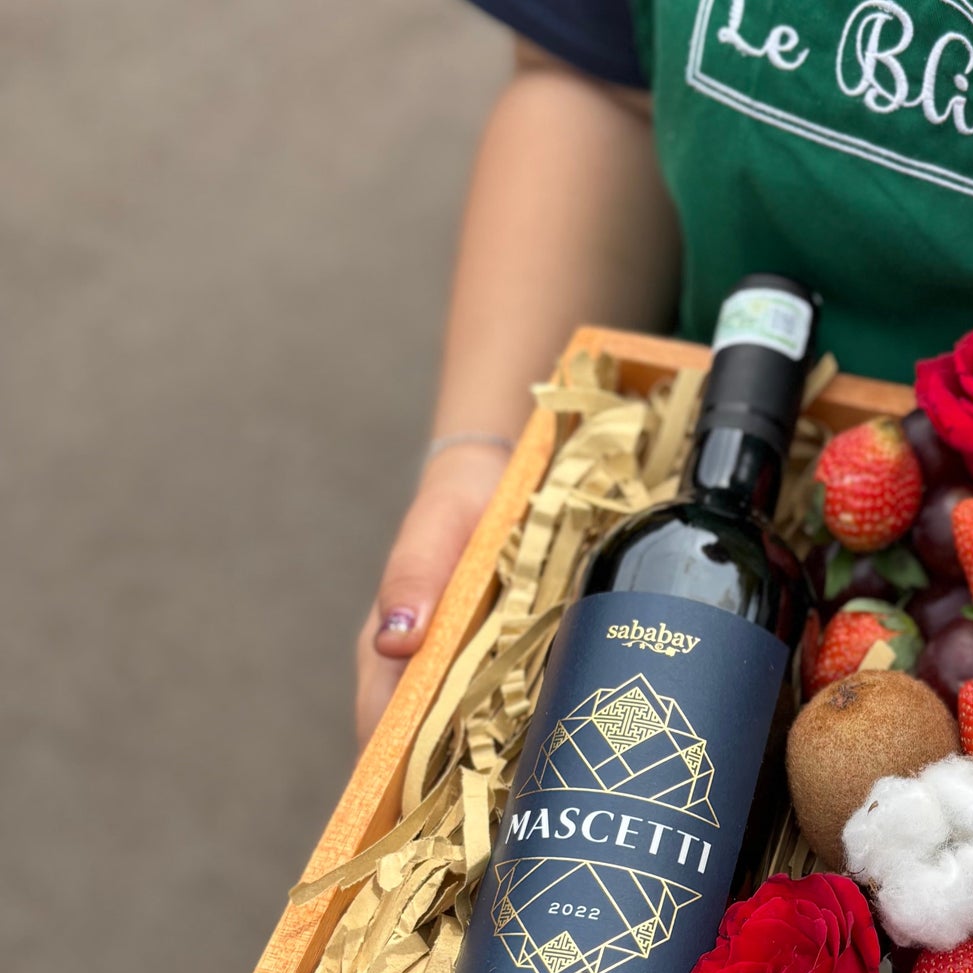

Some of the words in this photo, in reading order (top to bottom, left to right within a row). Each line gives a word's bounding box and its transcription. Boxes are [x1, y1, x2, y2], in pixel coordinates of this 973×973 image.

[606, 619, 701, 654] sababay
[505, 807, 712, 874] MASCETTI
[548, 902, 601, 920] 2022
